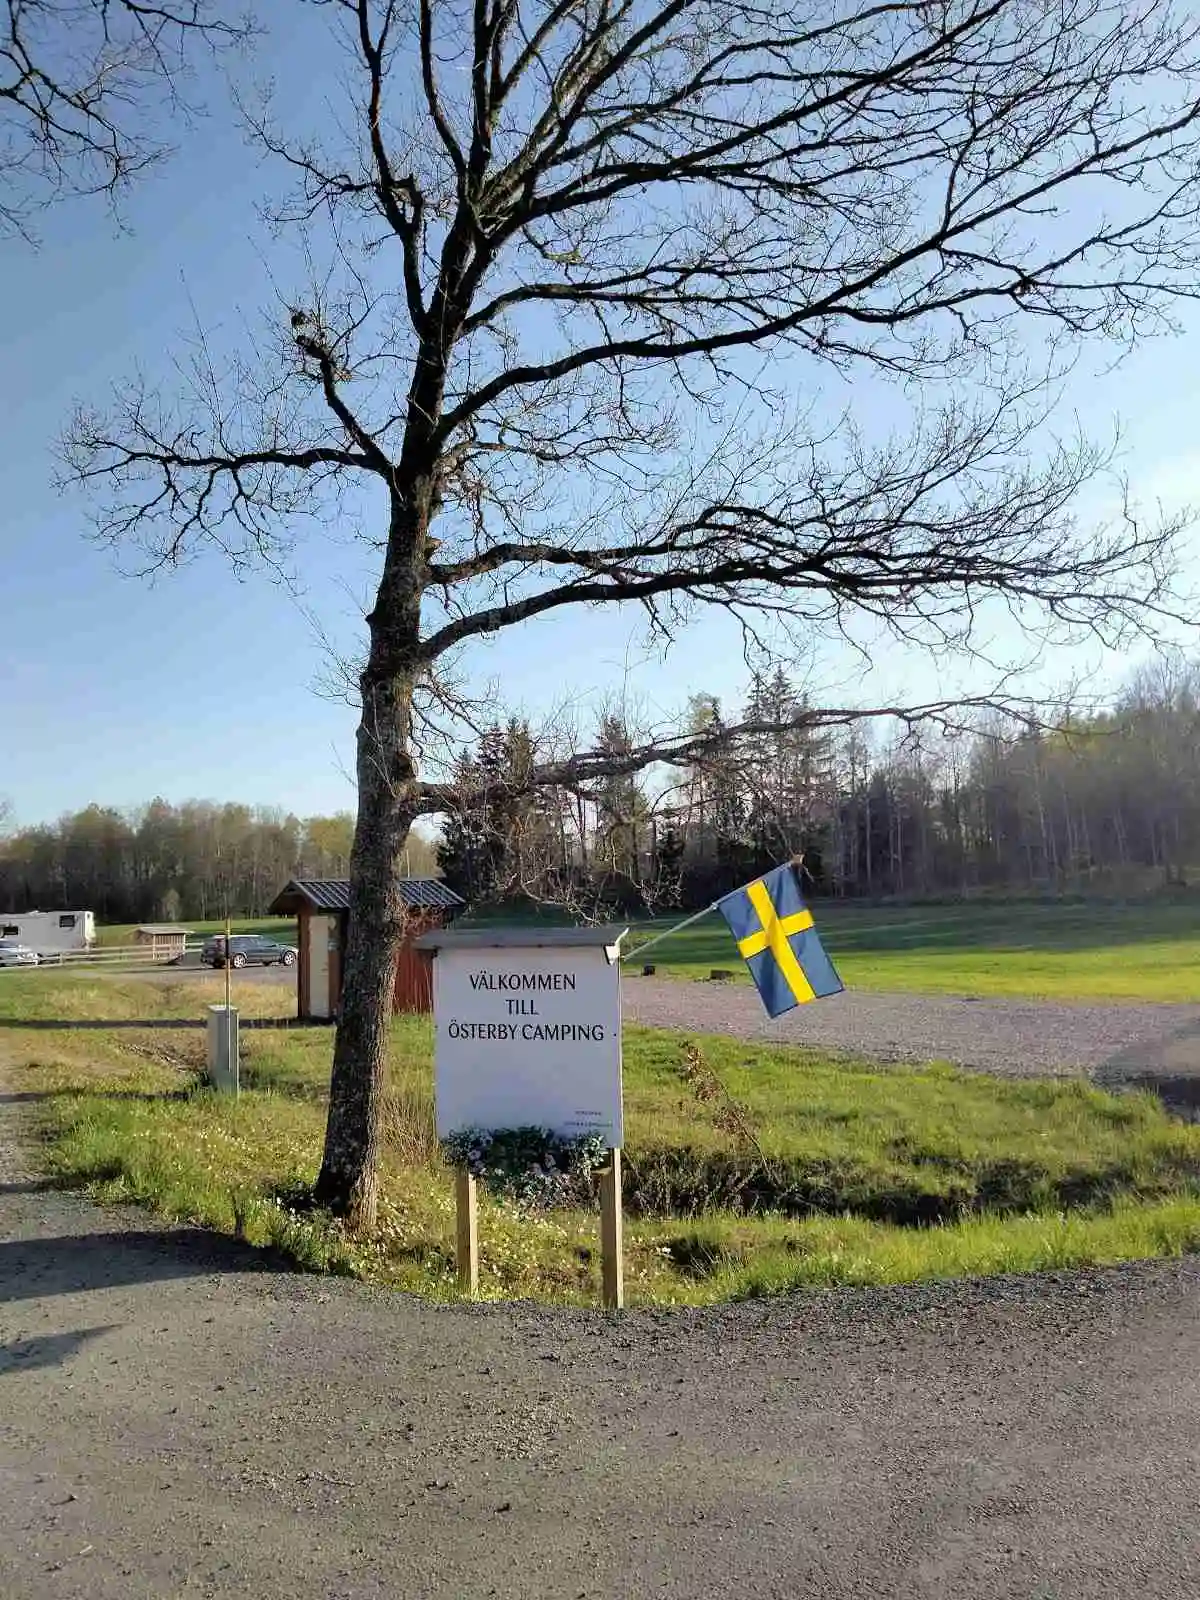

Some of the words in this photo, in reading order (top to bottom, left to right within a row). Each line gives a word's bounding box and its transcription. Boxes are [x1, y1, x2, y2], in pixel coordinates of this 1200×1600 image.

[469, 971, 576, 991] VÄLKOMMEN
[505, 999, 539, 1015] TILL
[448, 1020, 519, 1040] ÖSTERBY
[521, 1024, 604, 1041] CAMPING
